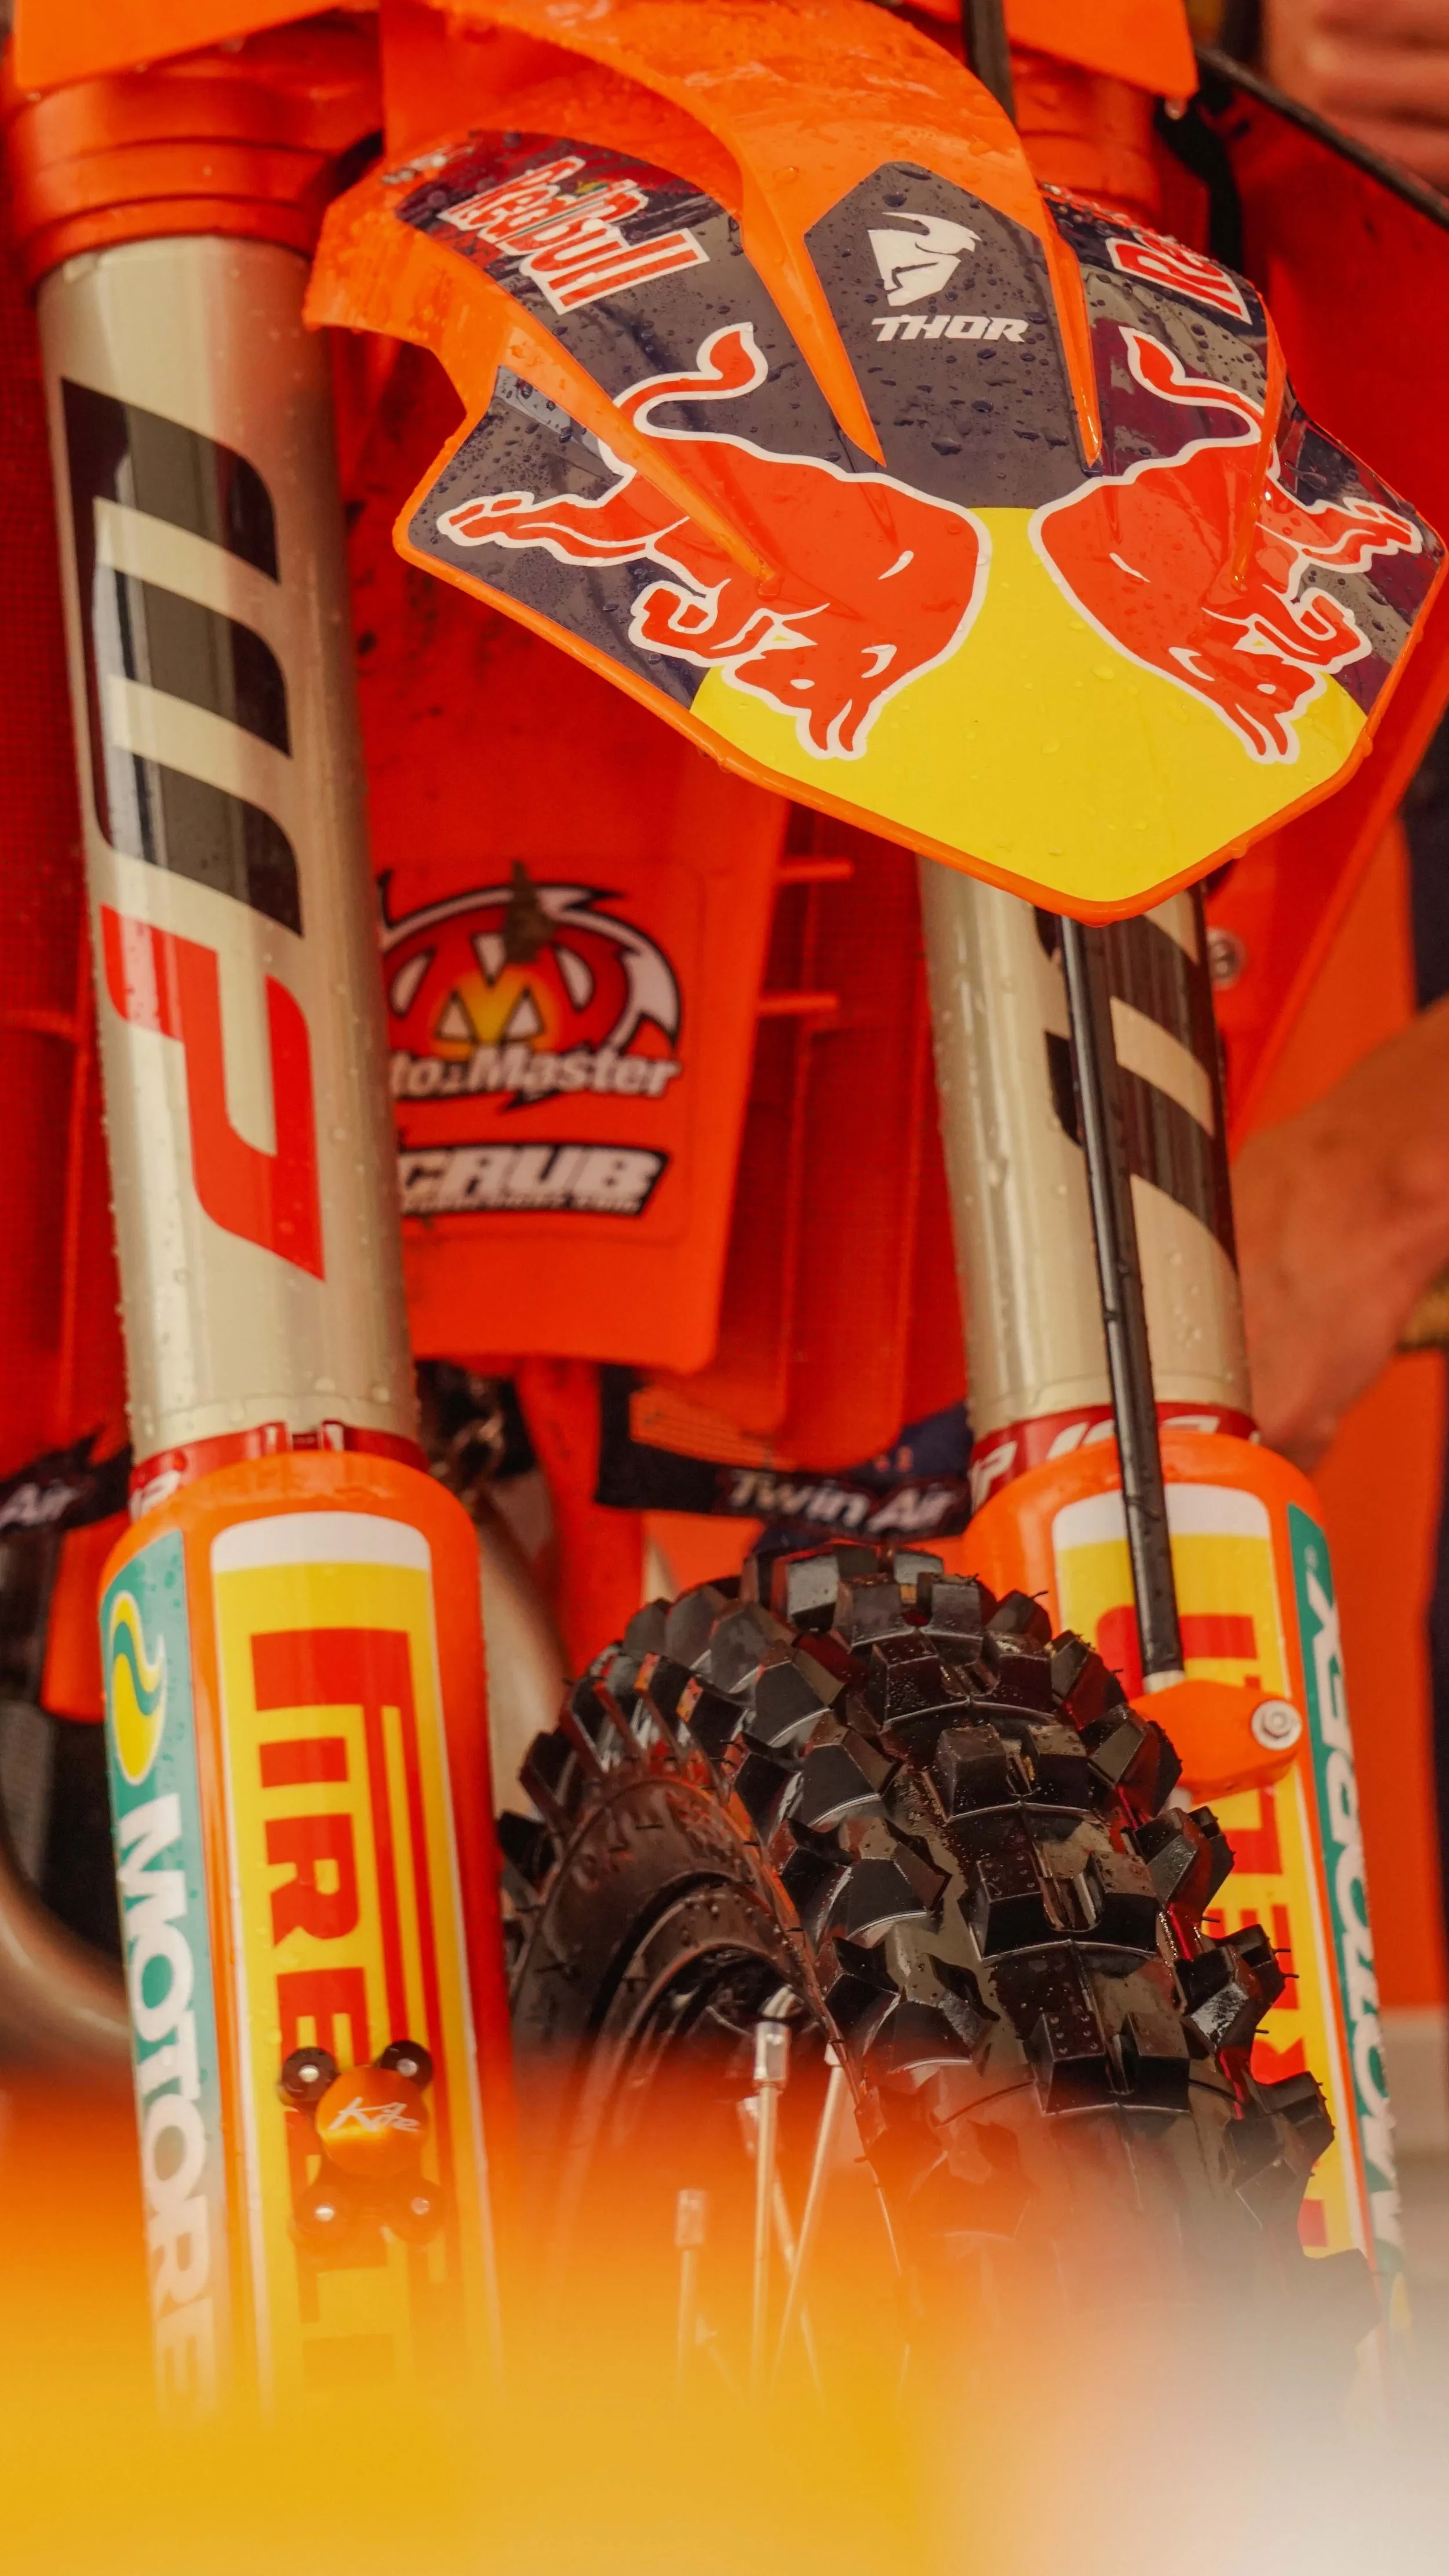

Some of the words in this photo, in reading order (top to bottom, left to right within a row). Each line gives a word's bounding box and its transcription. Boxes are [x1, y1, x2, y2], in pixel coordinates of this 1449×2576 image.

[871, 314, 1029, 343] THOR
[399, 1144, 664, 1206] CRUB
[730, 1468, 871, 1529] Twin
[118, 1792, 218, 2423] MOTORE
